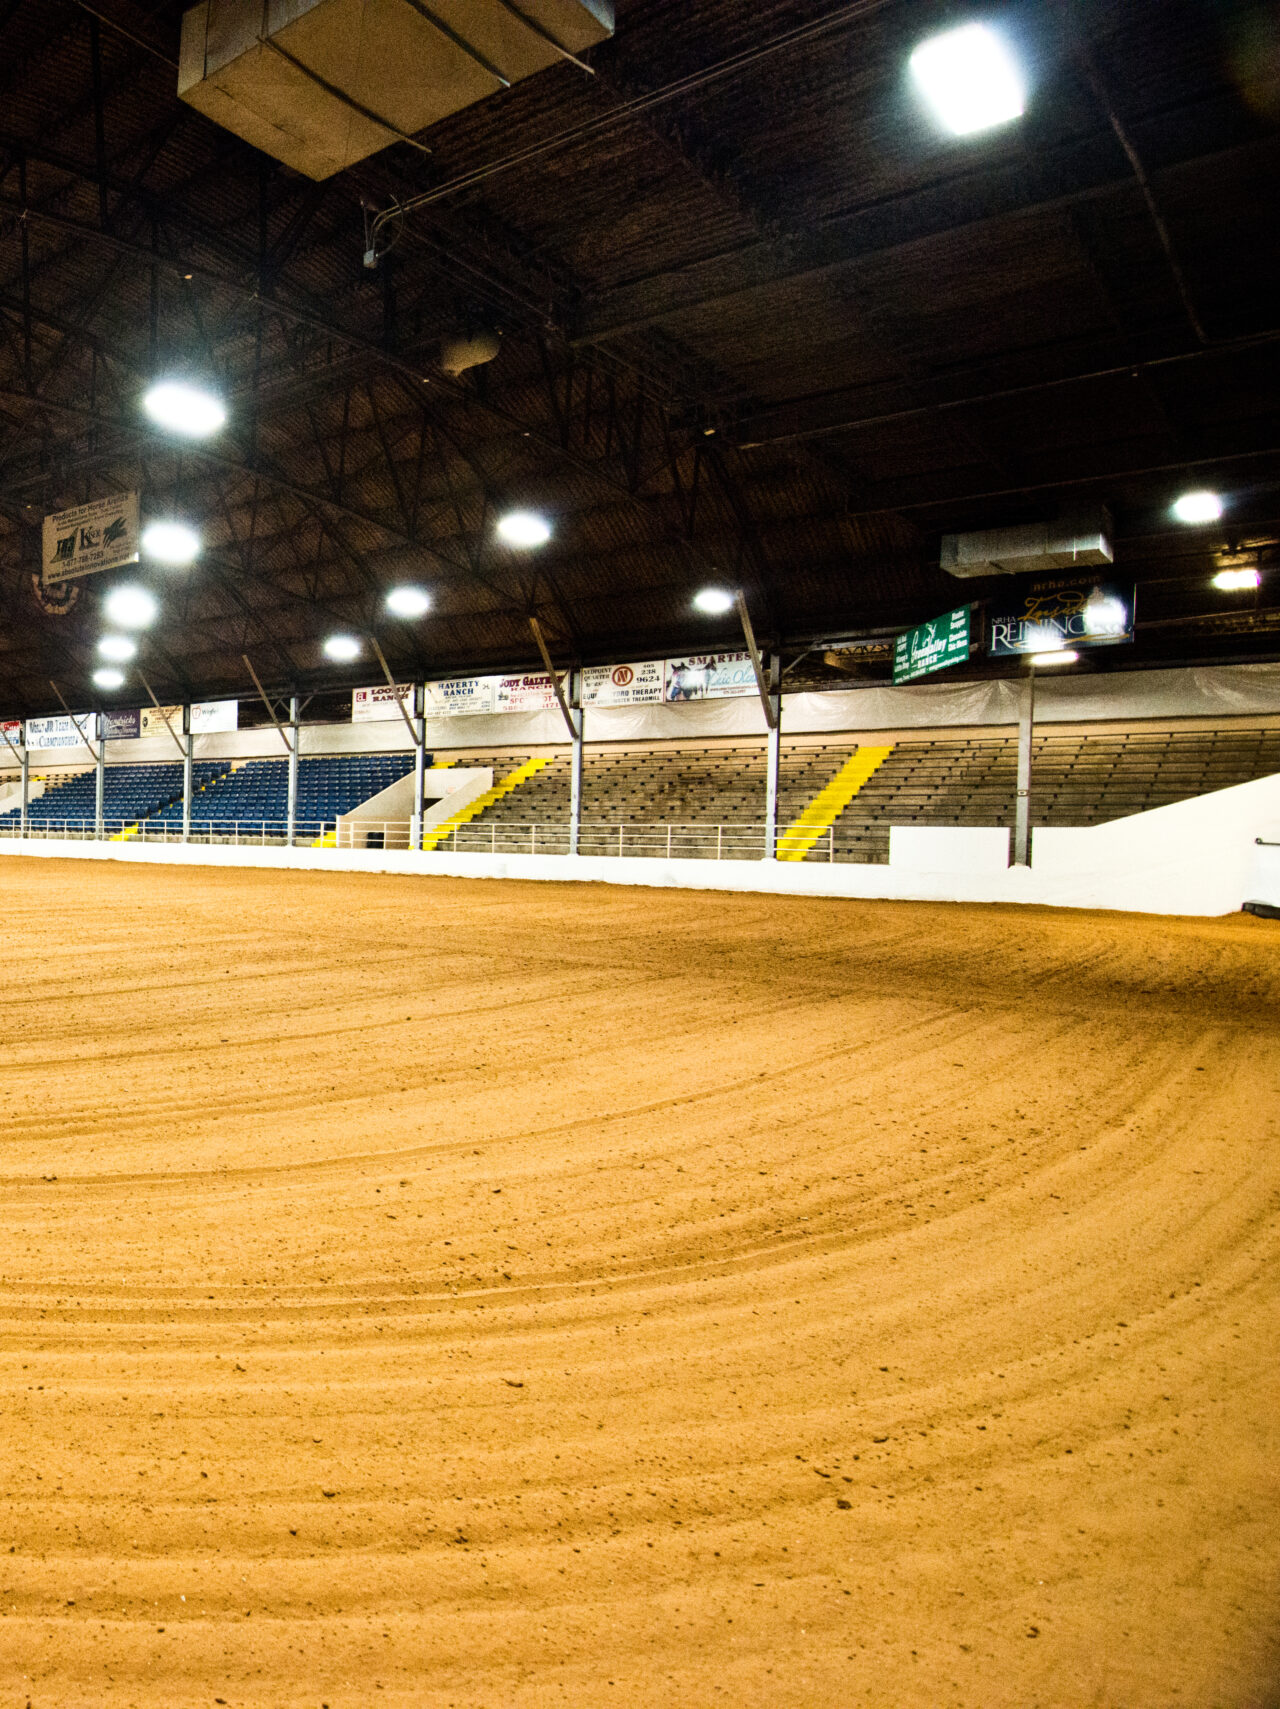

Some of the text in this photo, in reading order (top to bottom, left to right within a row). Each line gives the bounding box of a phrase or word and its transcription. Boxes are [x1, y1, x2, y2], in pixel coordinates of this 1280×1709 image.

[992, 616, 1017, 625] NRHA
[688, 651, 755, 666] SMARTES
[636, 675, 660, 683] 9624
[438, 680, 479, 689] HAVERTY
[443, 688, 474, 696] RANCH
[632, 687, 662, 696] THERAPY
